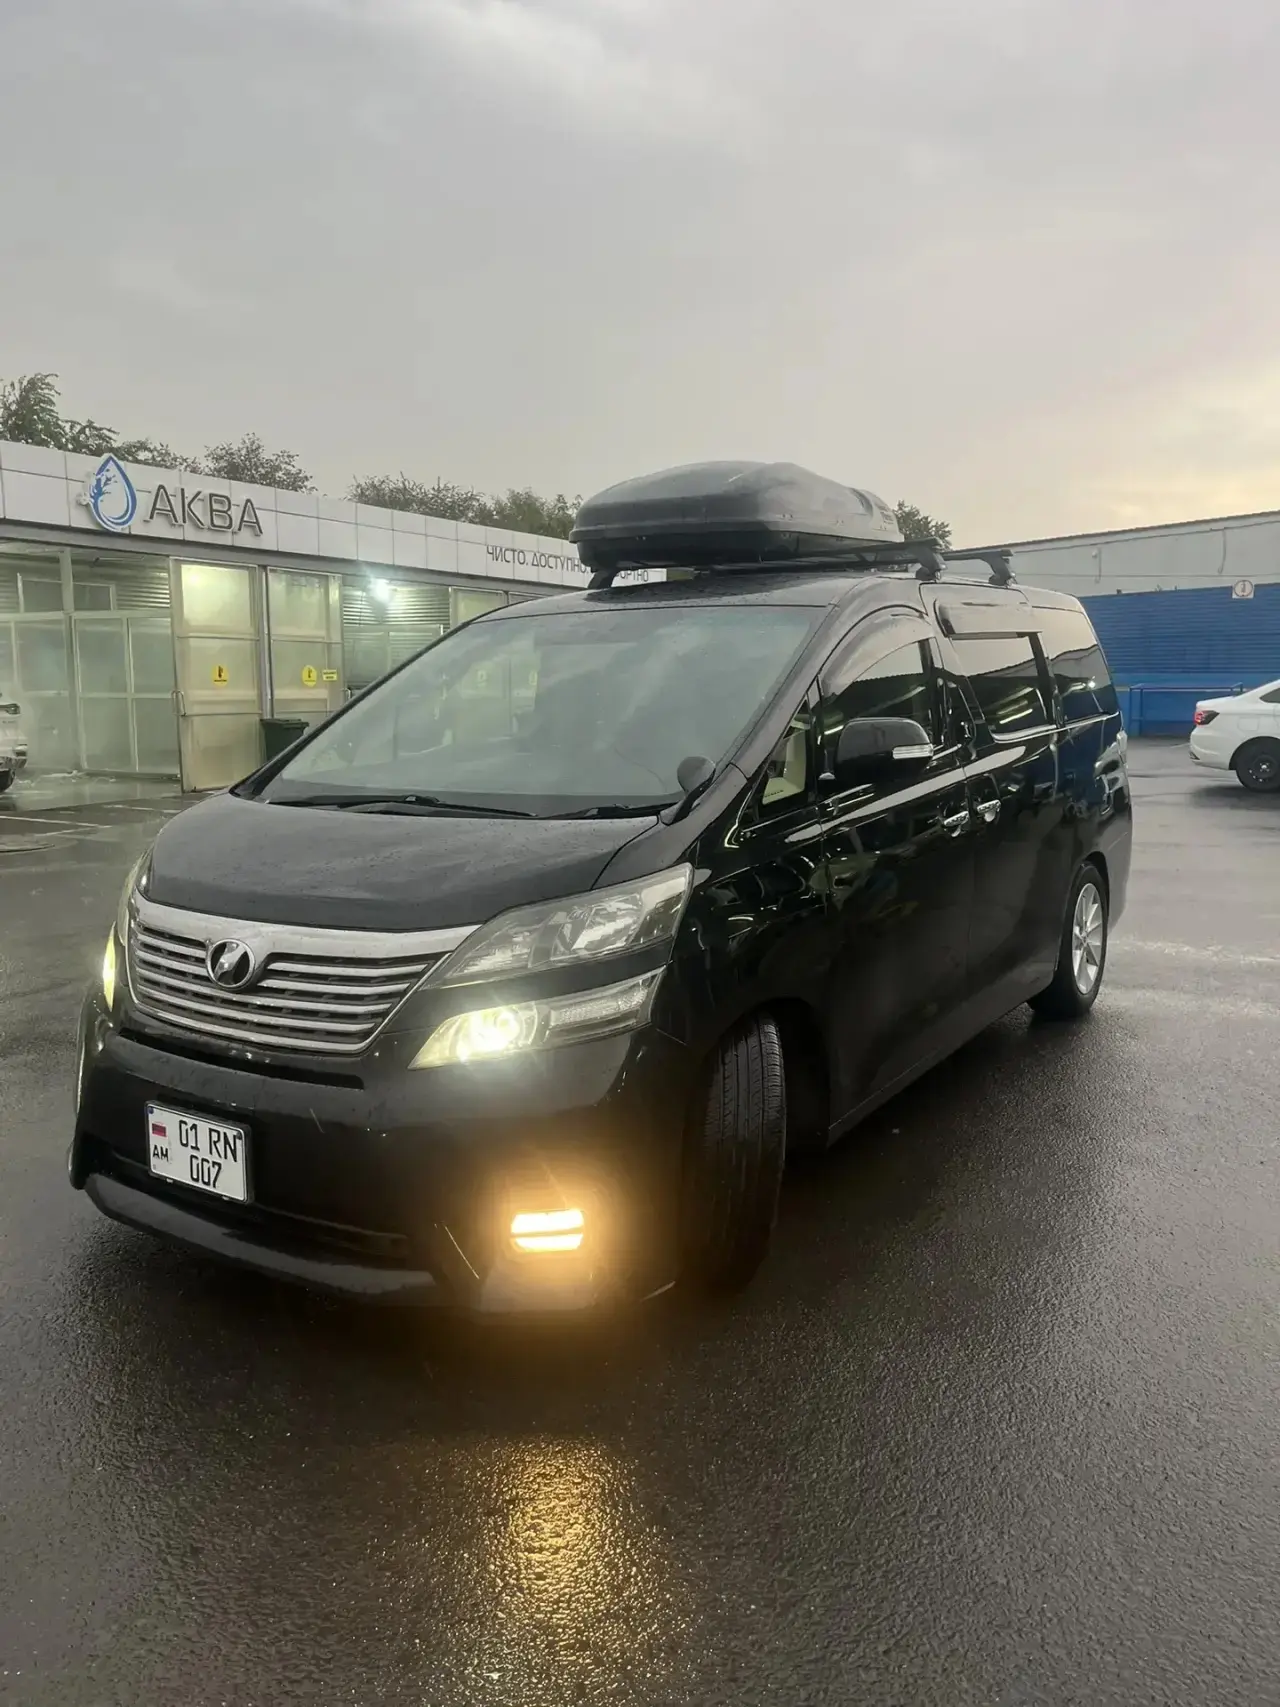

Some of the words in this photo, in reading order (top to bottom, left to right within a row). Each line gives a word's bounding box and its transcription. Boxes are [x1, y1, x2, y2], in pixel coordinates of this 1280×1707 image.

[149, 484, 263, 535] АКВА
[486, 545, 528, 566] ЧИСТО.
[152, 1144, 169, 1162] AM
[178, 1119, 200, 1152] 01
[208, 1127, 237, 1162] RN
[190, 1154, 222, 1188] 007
